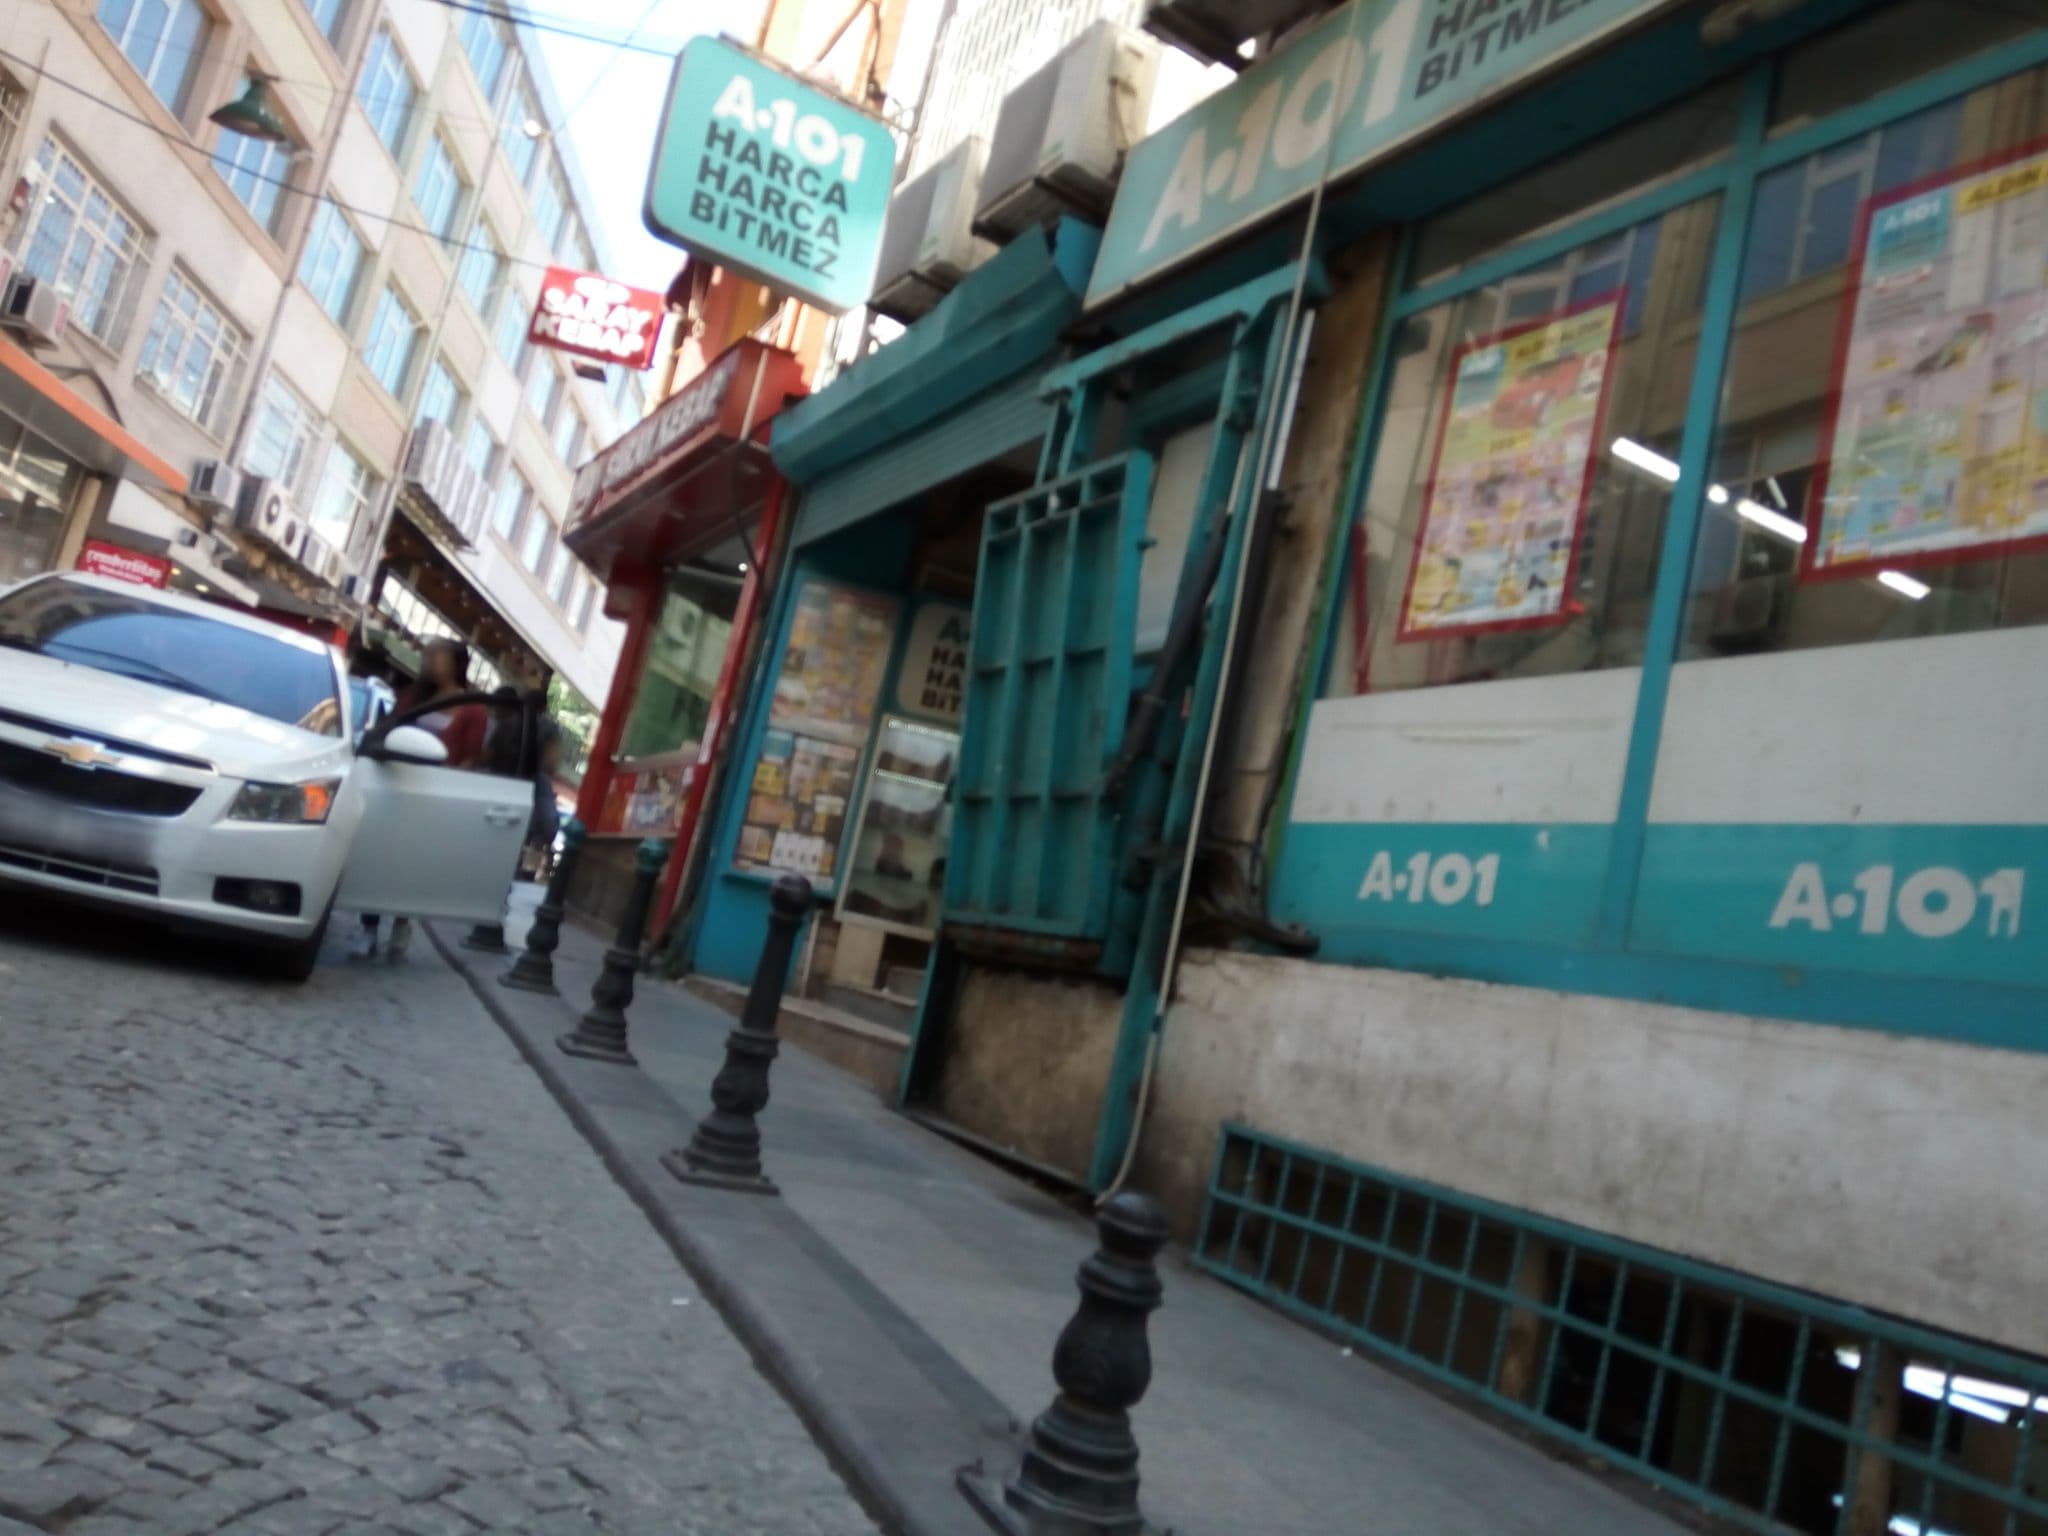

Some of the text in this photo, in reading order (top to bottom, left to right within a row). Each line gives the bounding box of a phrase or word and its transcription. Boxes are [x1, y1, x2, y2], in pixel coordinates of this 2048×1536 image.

[698, 154, 841, 247] HARCA
[705, 119, 848, 214] HARCA
[543, 288, 653, 334] SARAY
